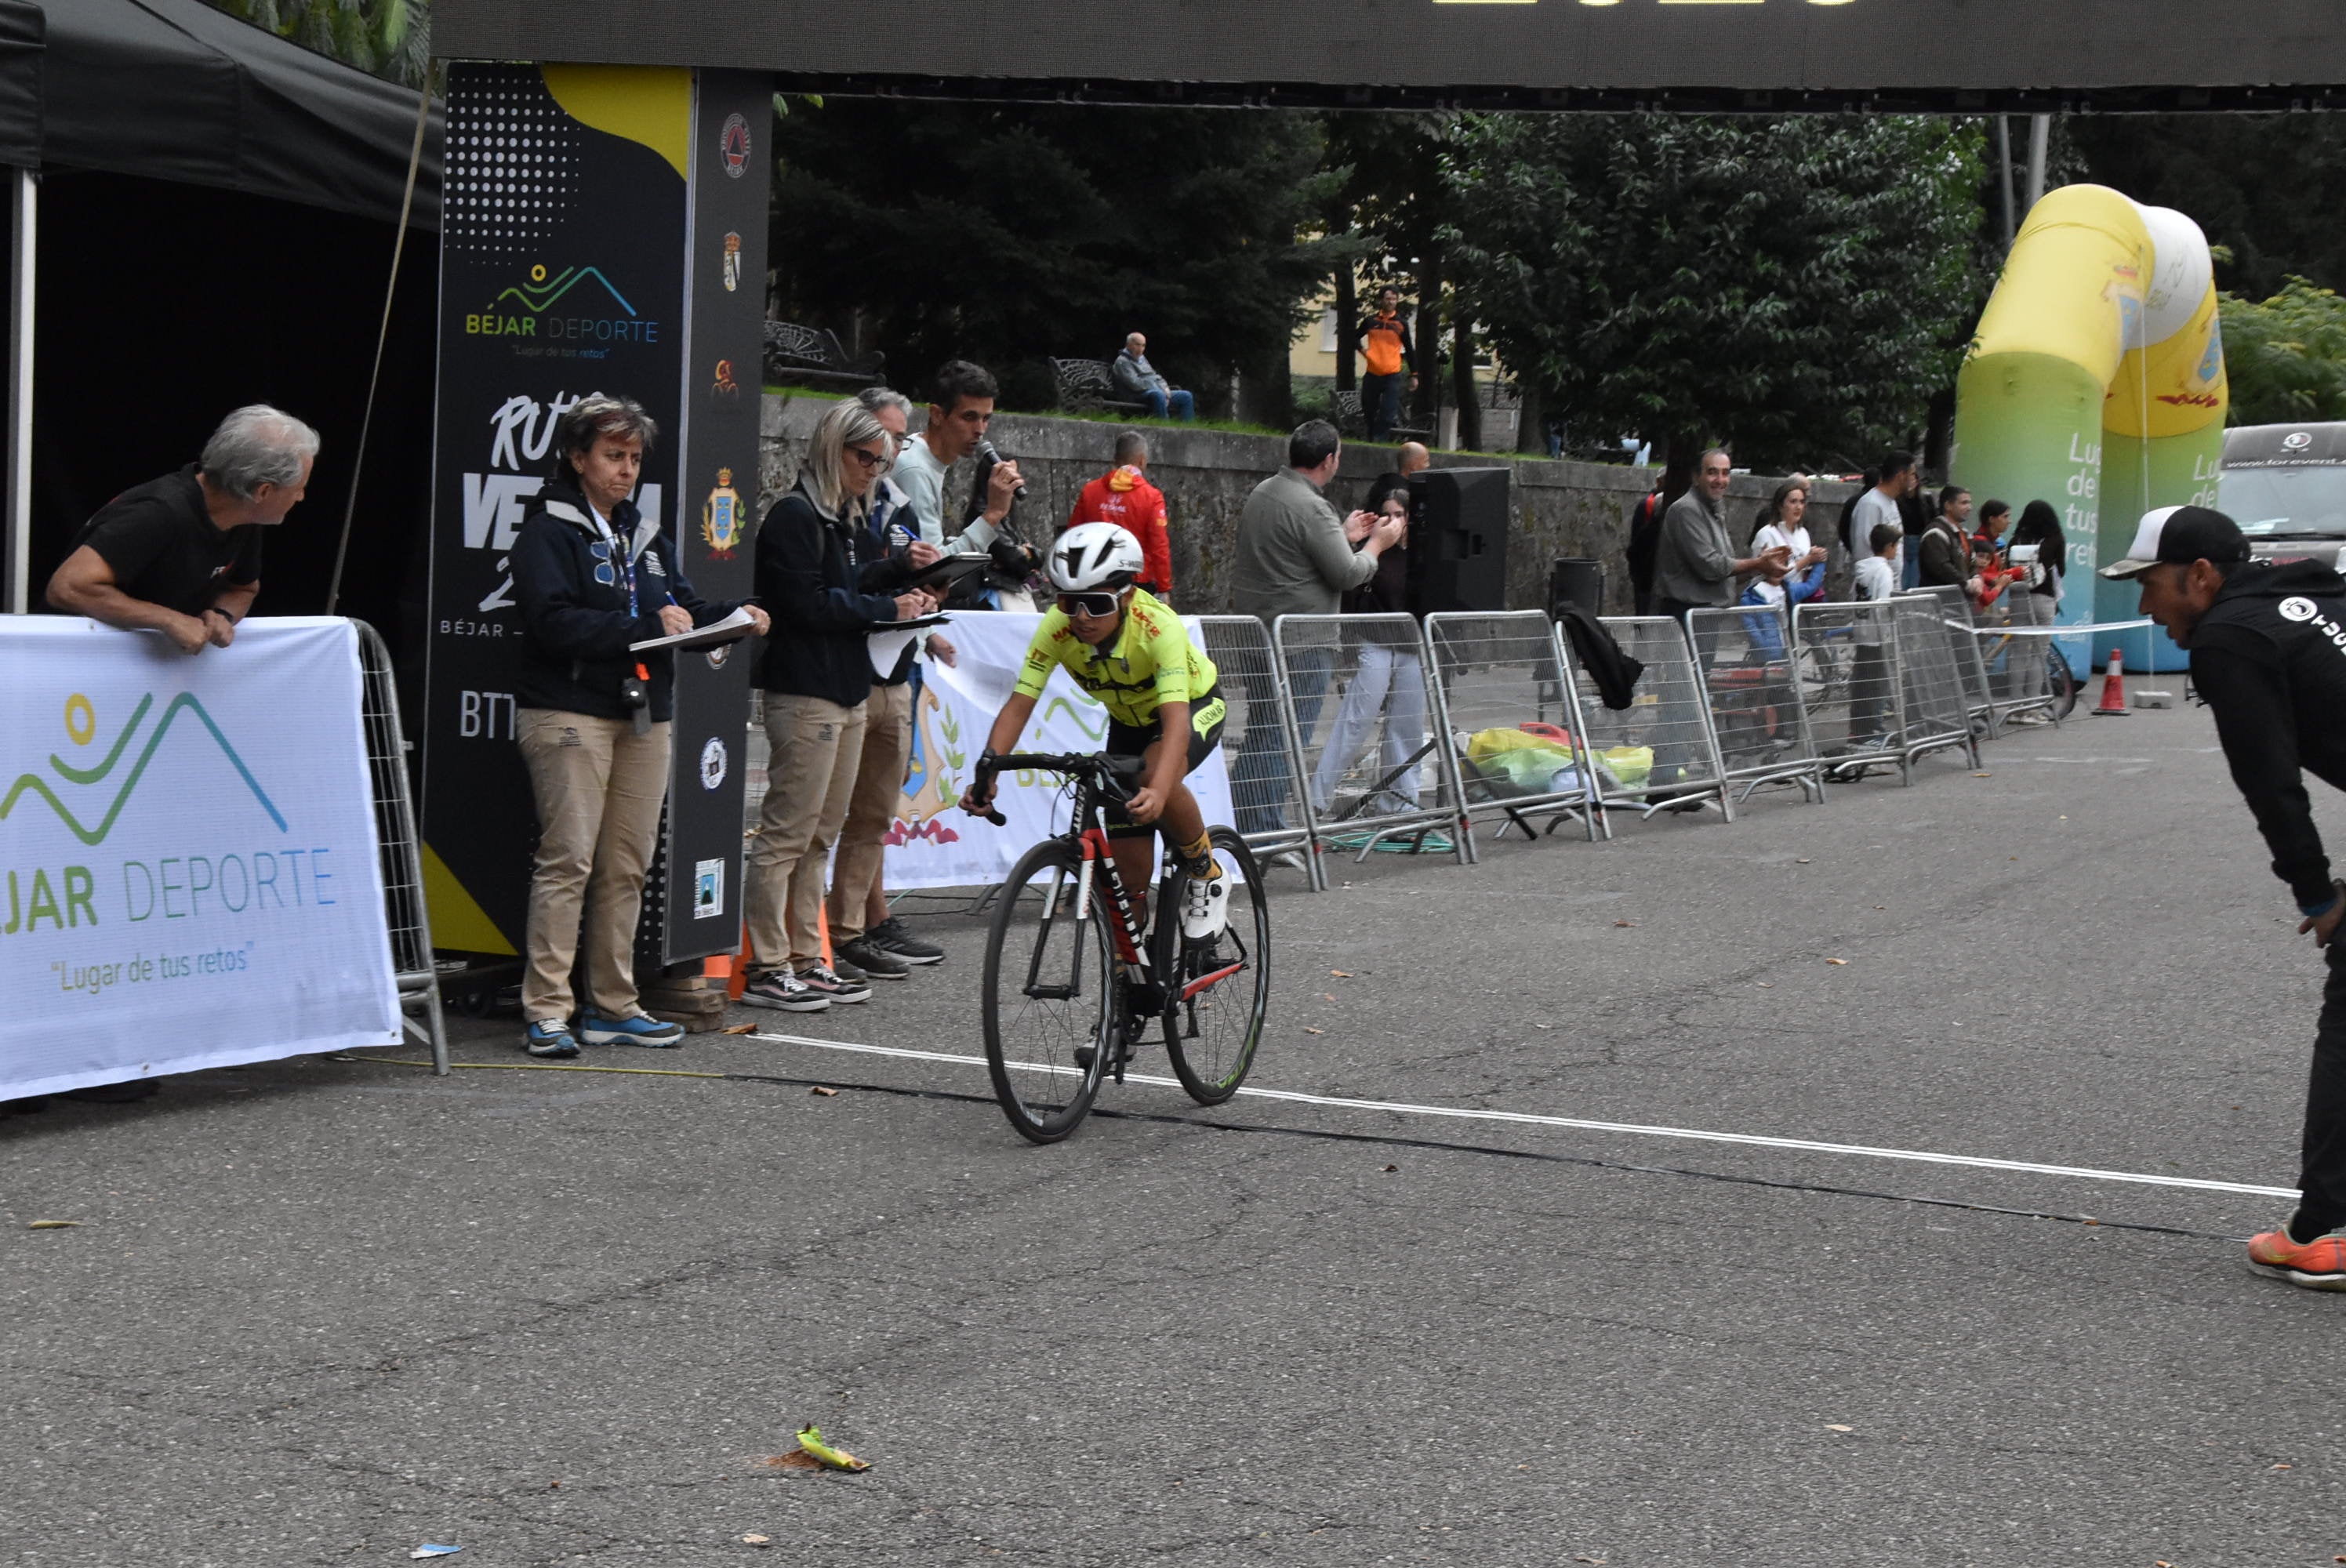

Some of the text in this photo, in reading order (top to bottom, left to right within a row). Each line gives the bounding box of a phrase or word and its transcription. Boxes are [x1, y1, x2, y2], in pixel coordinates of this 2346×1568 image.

[549, 317, 659, 343] DEPORTE
[2067, 468, 2096, 499] de
[440, 619, 503, 637] BÉJAR
[123, 848, 337, 922] DEPORTE
[128, 953, 154, 982] de
[159, 953, 191, 979] tus
